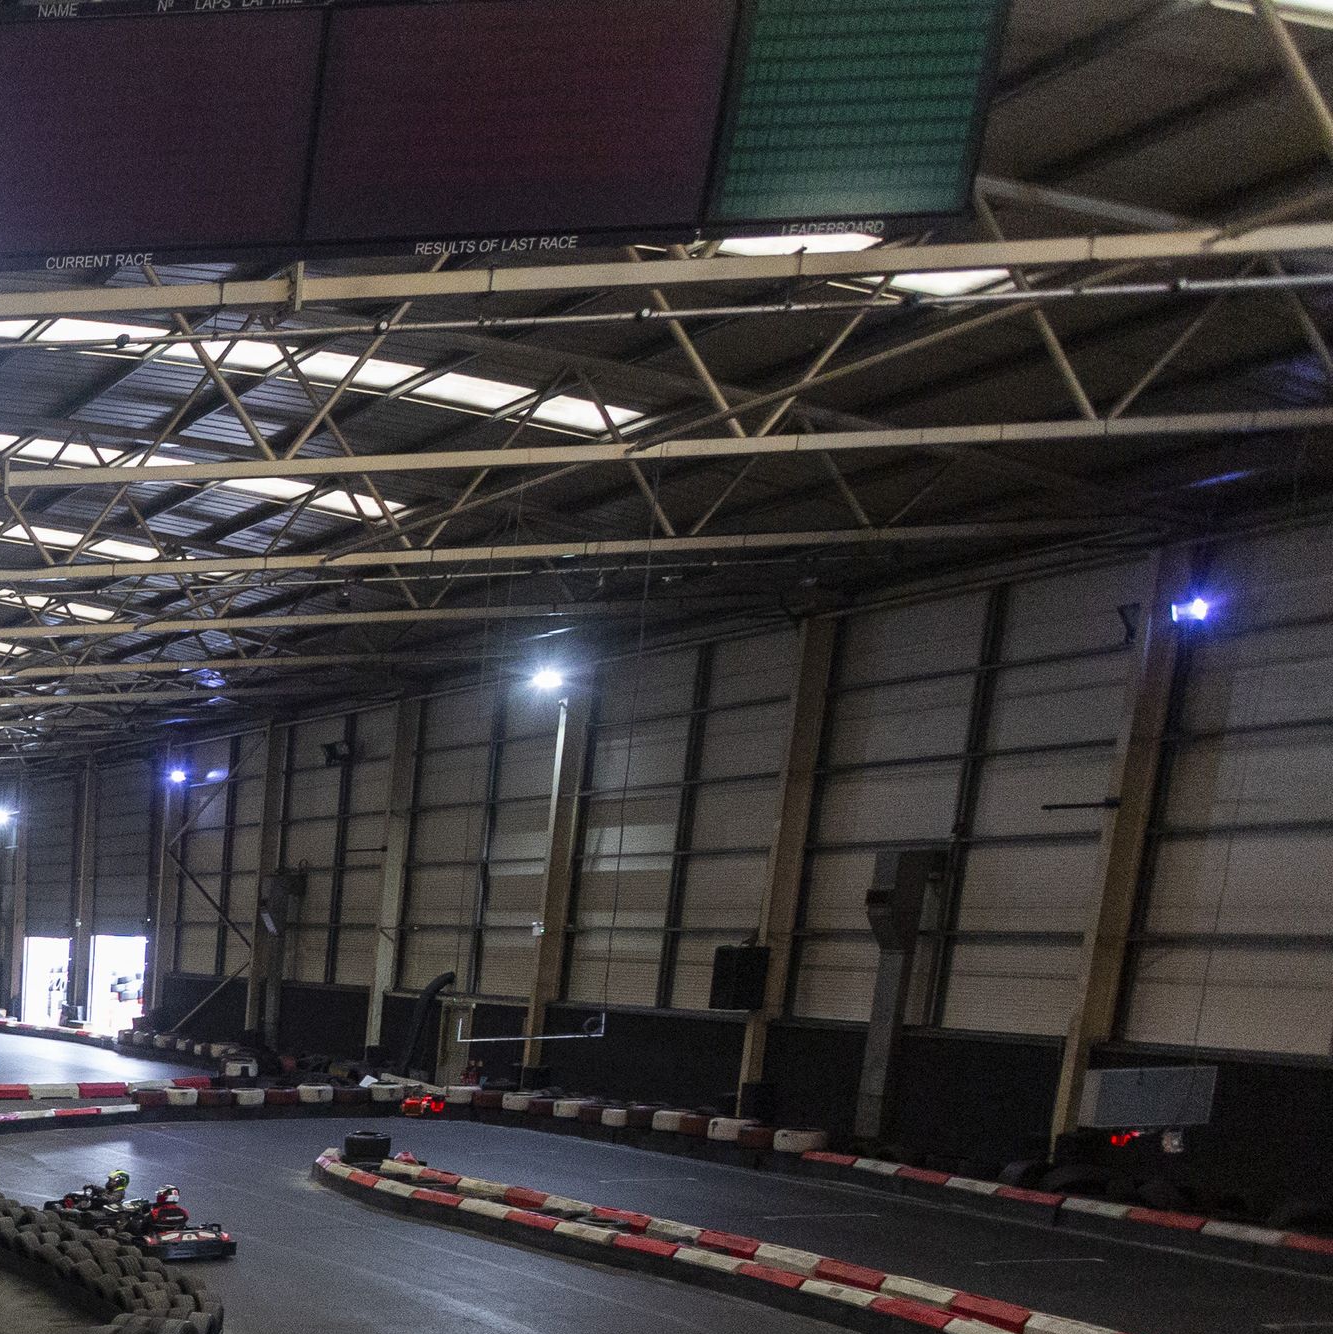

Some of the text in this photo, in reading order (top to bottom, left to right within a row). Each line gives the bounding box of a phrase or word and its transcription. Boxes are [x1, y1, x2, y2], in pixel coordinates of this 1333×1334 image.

[38, 4, 78, 18] NAME
[195, 0, 231, 10] LAPS
[781, 220, 885, 236] LEADERBOARD
[414, 235, 579, 255] RESULTS OF LAST RACE
[46, 252, 153, 269] CURRENT RACE
